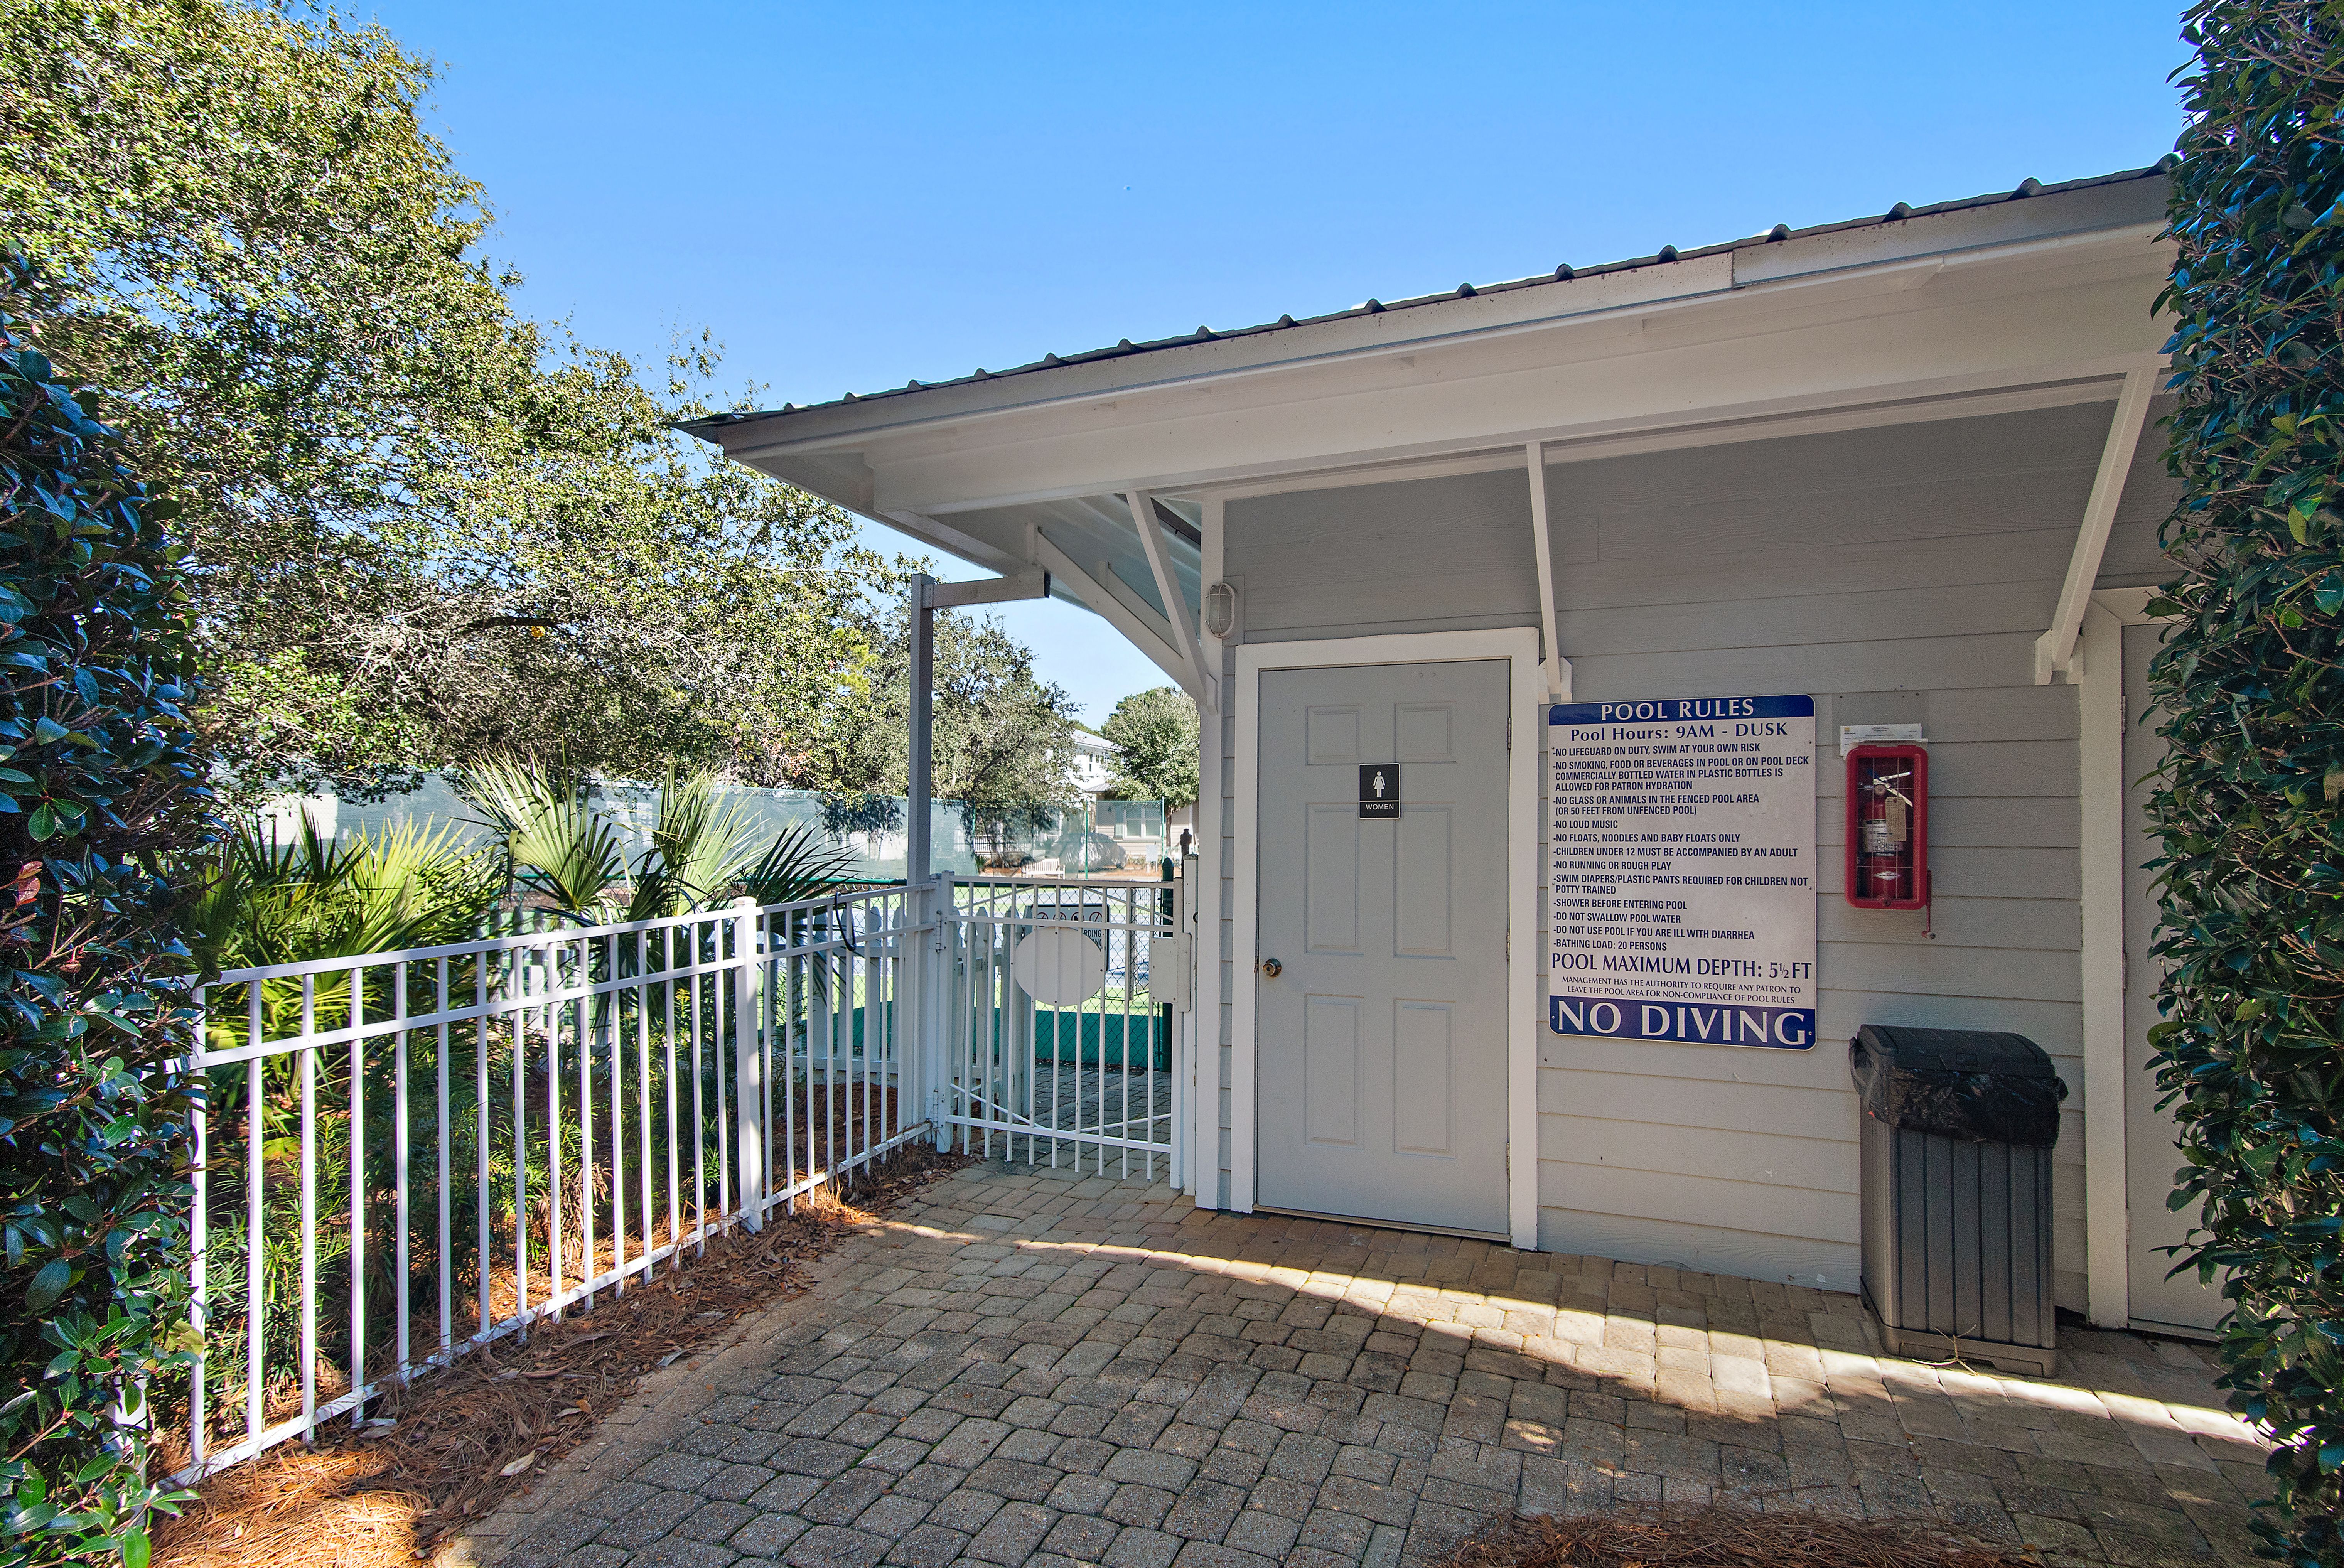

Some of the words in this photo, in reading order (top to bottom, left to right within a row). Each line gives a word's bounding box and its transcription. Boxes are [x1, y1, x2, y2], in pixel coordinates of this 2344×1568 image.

[1602, 703, 1667, 720] POOL
[1680, 699, 1753, 717] RULES
[1572, 728, 1604, 741] Pool
[1613, 728, 1668, 740] Hours:
[1676, 725, 1714, 738] 9AM
[1736, 723, 1787, 736] DUSK
[1570, 747, 1611, 756] LIFEGUARD
[1614, 747, 1625, 755] ON
[1629, 746, 1650, 755] DUTY,
[1653, 745, 1676, 754] SWIM
[1680, 745, 1690, 753] AT
[1692, 744, 1714, 753] YOUR
[1717, 744, 1738, 752] OWN
[1741, 743, 1760, 752] RISK
[1569, 761, 1607, 769] SMOKING,
[1647, 759, 1693, 767] BEVERAGES
[1697, 759, 1705, 767] IN
[1708, 758, 1730, 766] POOL
[1732, 758, 1743, 766] OR
[1746, 757, 1758, 765] ON
[1761, 757, 1783, 765] POOL
[1786, 756, 1809, 765] DECK
[1556, 771, 1616, 780] COMMERCIALLY
[1619, 771, 1653, 779] BOTTLED
[1656, 770, 1684, 778] WATER
[1687, 770, 1695, 778] IN
[1699, 769, 1732, 778] PLASTIC
[1736, 768, 1772, 777] BOTTLES
[1775, 768, 1783, 776] IS
[1556, 783, 1592, 791] ALLOWED
[1612, 782, 1643, 790] PATRON
[1646, 781, 1692, 790] HYDRATION
[1609, 796, 1646, 804] ANIMALS
[1660, 795, 1675, 803] THE
[1678, 795, 1709, 803] FENCED
[1713, 794, 1734, 803] POOL
[1736, 794, 1759, 803] AREA
[1556, 807, 1568, 816] (OR
[1673, 806, 1696, 816] POOL)
[1570, 820, 1589, 828] LOUD
[1592, 820, 1617, 828] MUSIC
[1570, 834, 1599, 842] FLOATS,
[1602, 834, 1638, 842] NOODLES
[1641, 834, 1658, 842] AND
[1686, 834, 1716, 842] FLOATS
[1719, 834, 1740, 842] ONLY
[1676, 848, 1738, 856] ACCOMPANIED
[1741, 848, 1752, 856] BY
[1754, 848, 1766, 856] AN
[1769, 848, 1798, 857] ADULT
[1570, 861, 1605, 869] RUNNING
[1622, 862, 1648, 870] ROUGH
[1582, 875, 1650, 883] DIAPERS/PLASTIC
[1653, 876, 1680, 884] PANTS
[1683, 876, 1723, 884] REQUIRED
[1727, 877, 1742, 885] FOR
[1745, 877, 1787, 885] CHILDREN
[1791, 877, 1808, 886] NOT
[1556, 885, 1580, 893] POTTY
[1592, 899, 1621, 908] BEFORE
[1624, 900, 1663, 909] ENTERING
[1666, 901, 1687, 909] POOL
[1587, 913, 1627, 921] SWALLOW
[1630, 914, 1650, 922] POOL
[1652, 914, 1681, 923] WATER
[1605, 927, 1625, 935] POOL
[1637, 928, 1652, 936] YOU
[1655, 929, 1671, 937] ARE
[1674, 929, 1685, 937] ILL
[1687, 929, 1708, 938] WITH
[1712, 930, 1754, 939] DIARRHEA
[1593, 940, 1615, 949] LOAD:
[1630, 942, 1667, 951] PERSONS
[1553, 953, 1597, 969] POOL
[1603, 955, 1690, 974] MAXIMUM
[1698, 959, 1761, 977] DEPTH:
[1704, 983, 1736, 991] REQUIRE
[1663, 991, 1732, 1000] NON-COMPLIANCE
[1559, 1001, 1621, 1033] NO
[1642, 1005, 1805, 1045] DIVING
